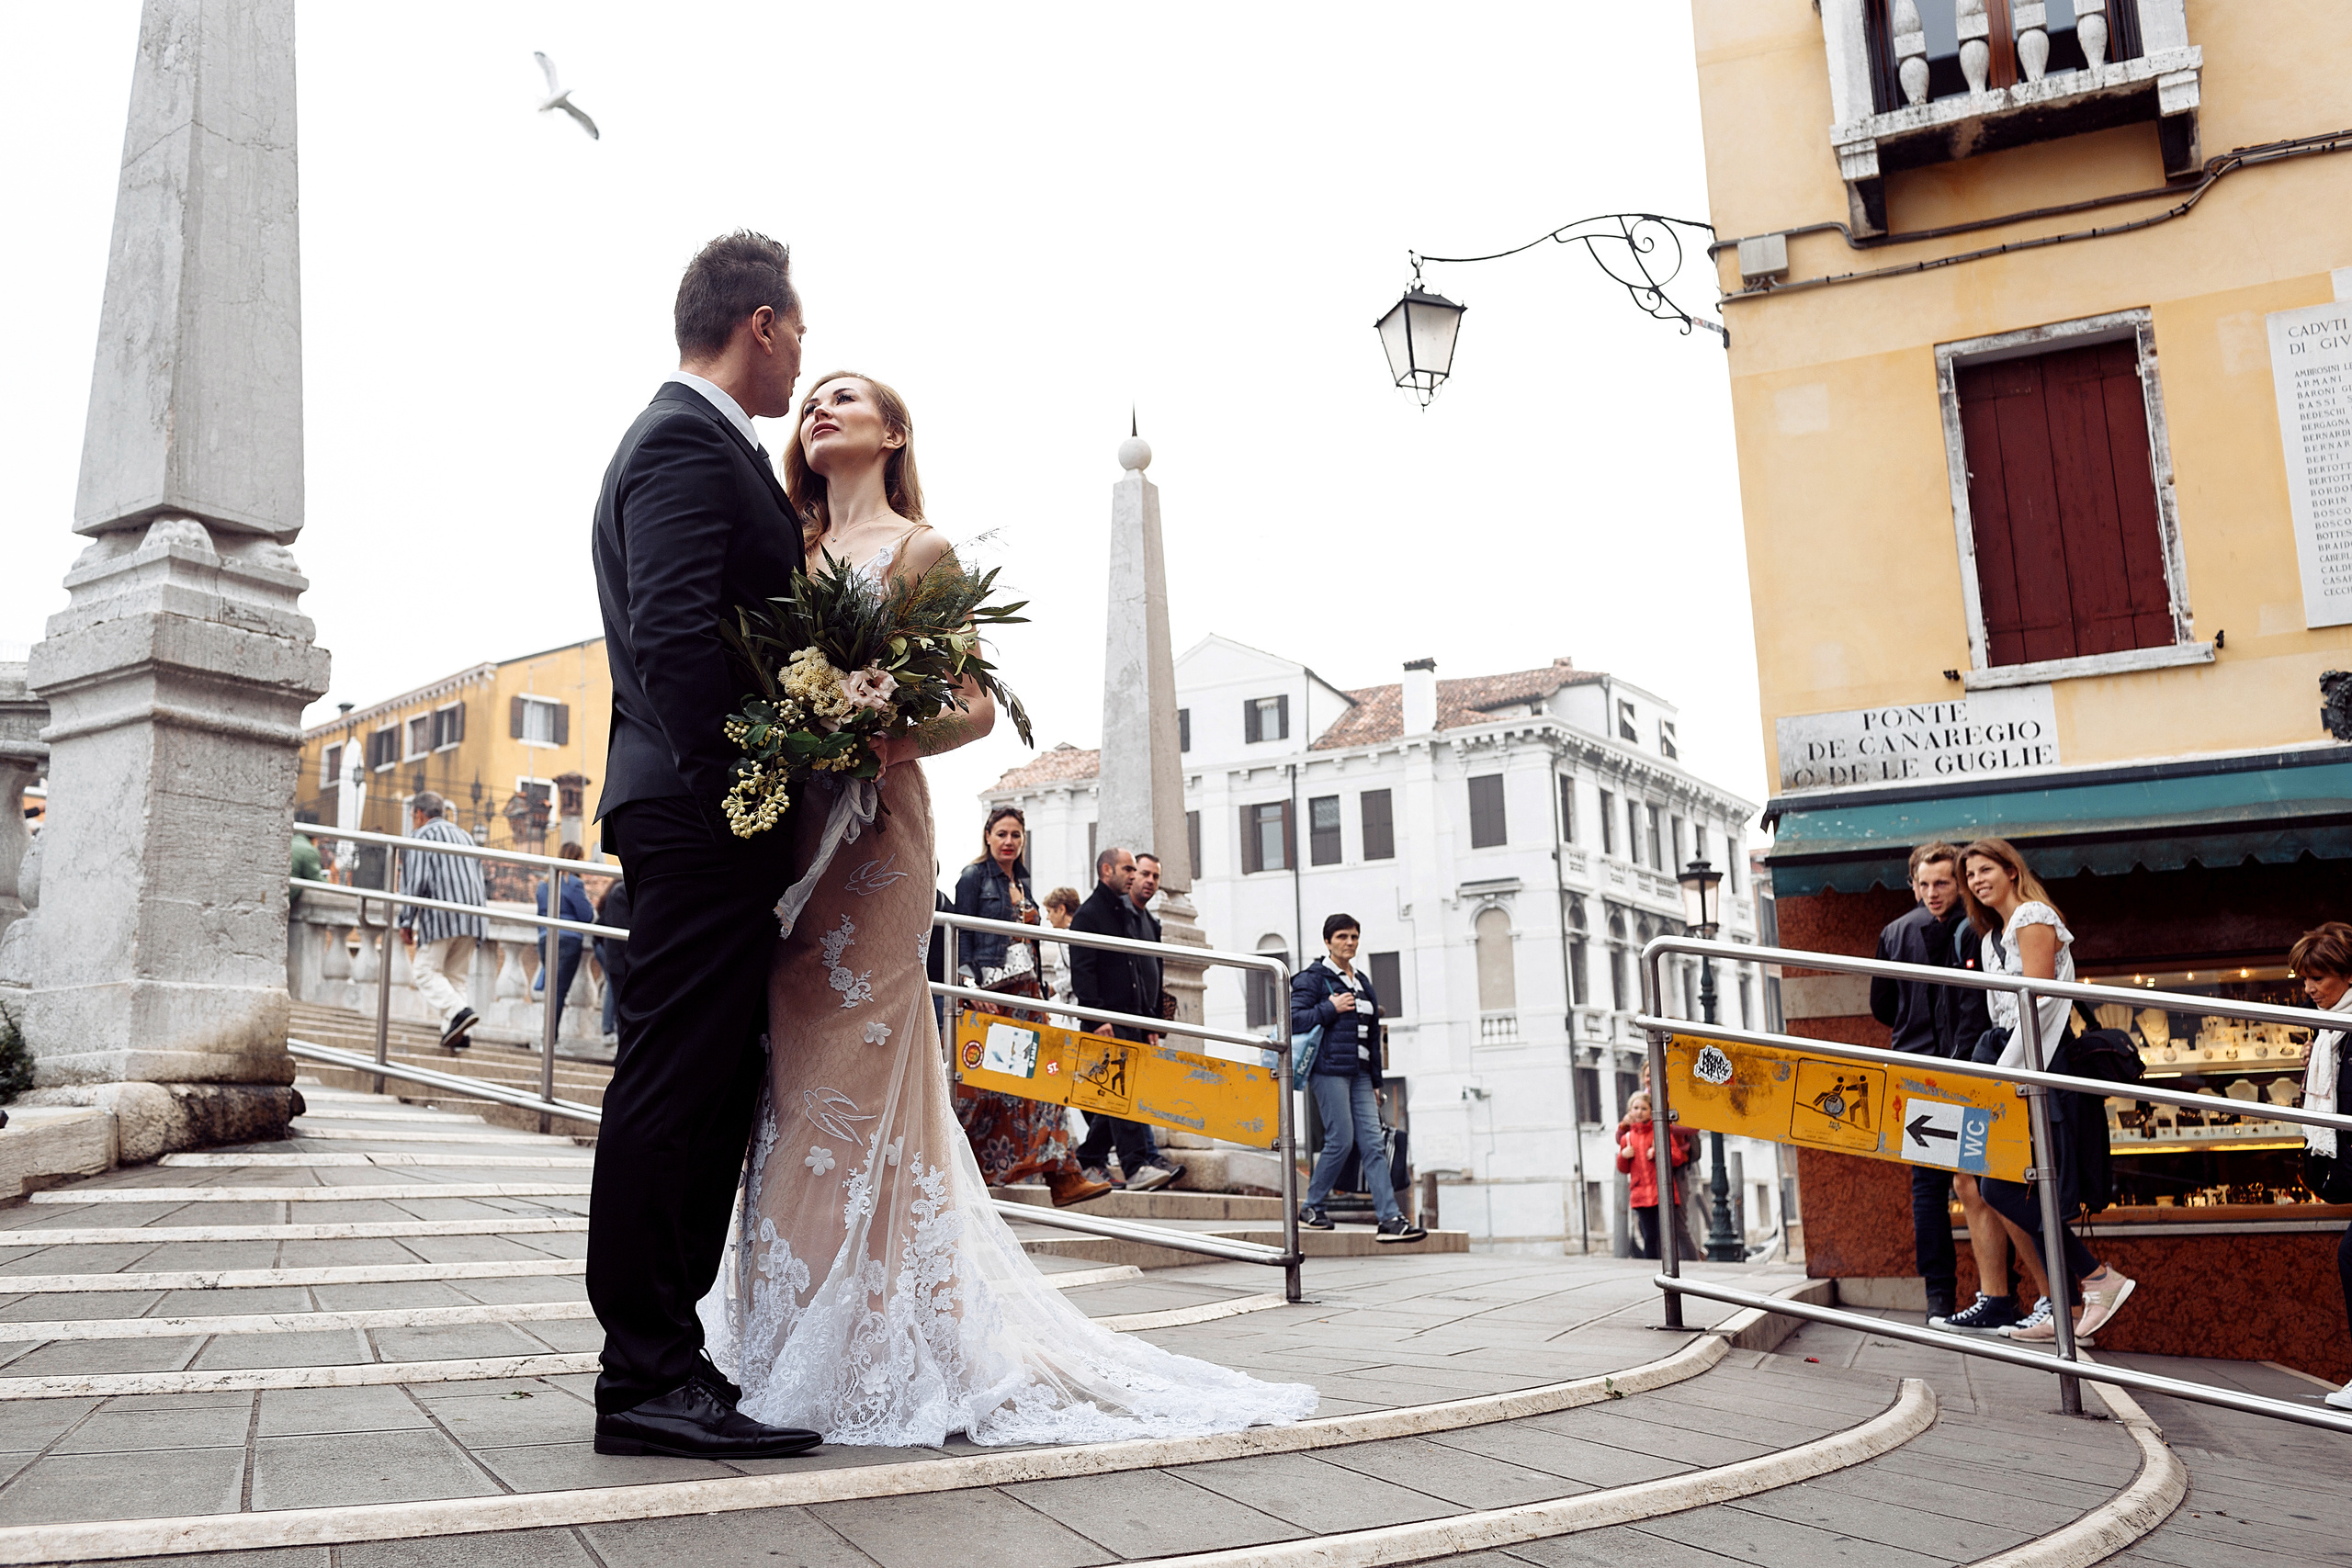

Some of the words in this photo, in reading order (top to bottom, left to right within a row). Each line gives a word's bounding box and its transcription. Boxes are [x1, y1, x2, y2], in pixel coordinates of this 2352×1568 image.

[2288, 318, 2347, 338] CADVTI
[2290, 342, 2305, 355] DI
[2295, 364, 2340, 378] AMBROSINI
[2296, 375, 2342, 389] ARMANI
[2297, 387, 2335, 400] BARONI
[2299, 398, 2335, 410] BASSI
[2300, 407, 2346, 421] BEDESCHI
[2306, 453, 2339, 464] BERTI
[2312, 496, 2347, 508] BORIN
[2313, 507, 2351, 519] BOSCO
[2318, 540, 2352, 551] BRAID
[1862, 702, 1968, 730] PONTE
[1808, 740, 1846, 761] DE
[1859, 720, 2041, 755] CANAREGIO
[1793, 769, 1815, 786] O
[1829, 762, 1869, 783] DE
[1882, 758, 1919, 779] LE
[1935, 744, 2053, 774] GUGLIE
[1963, 1120, 1985, 1156] WC
